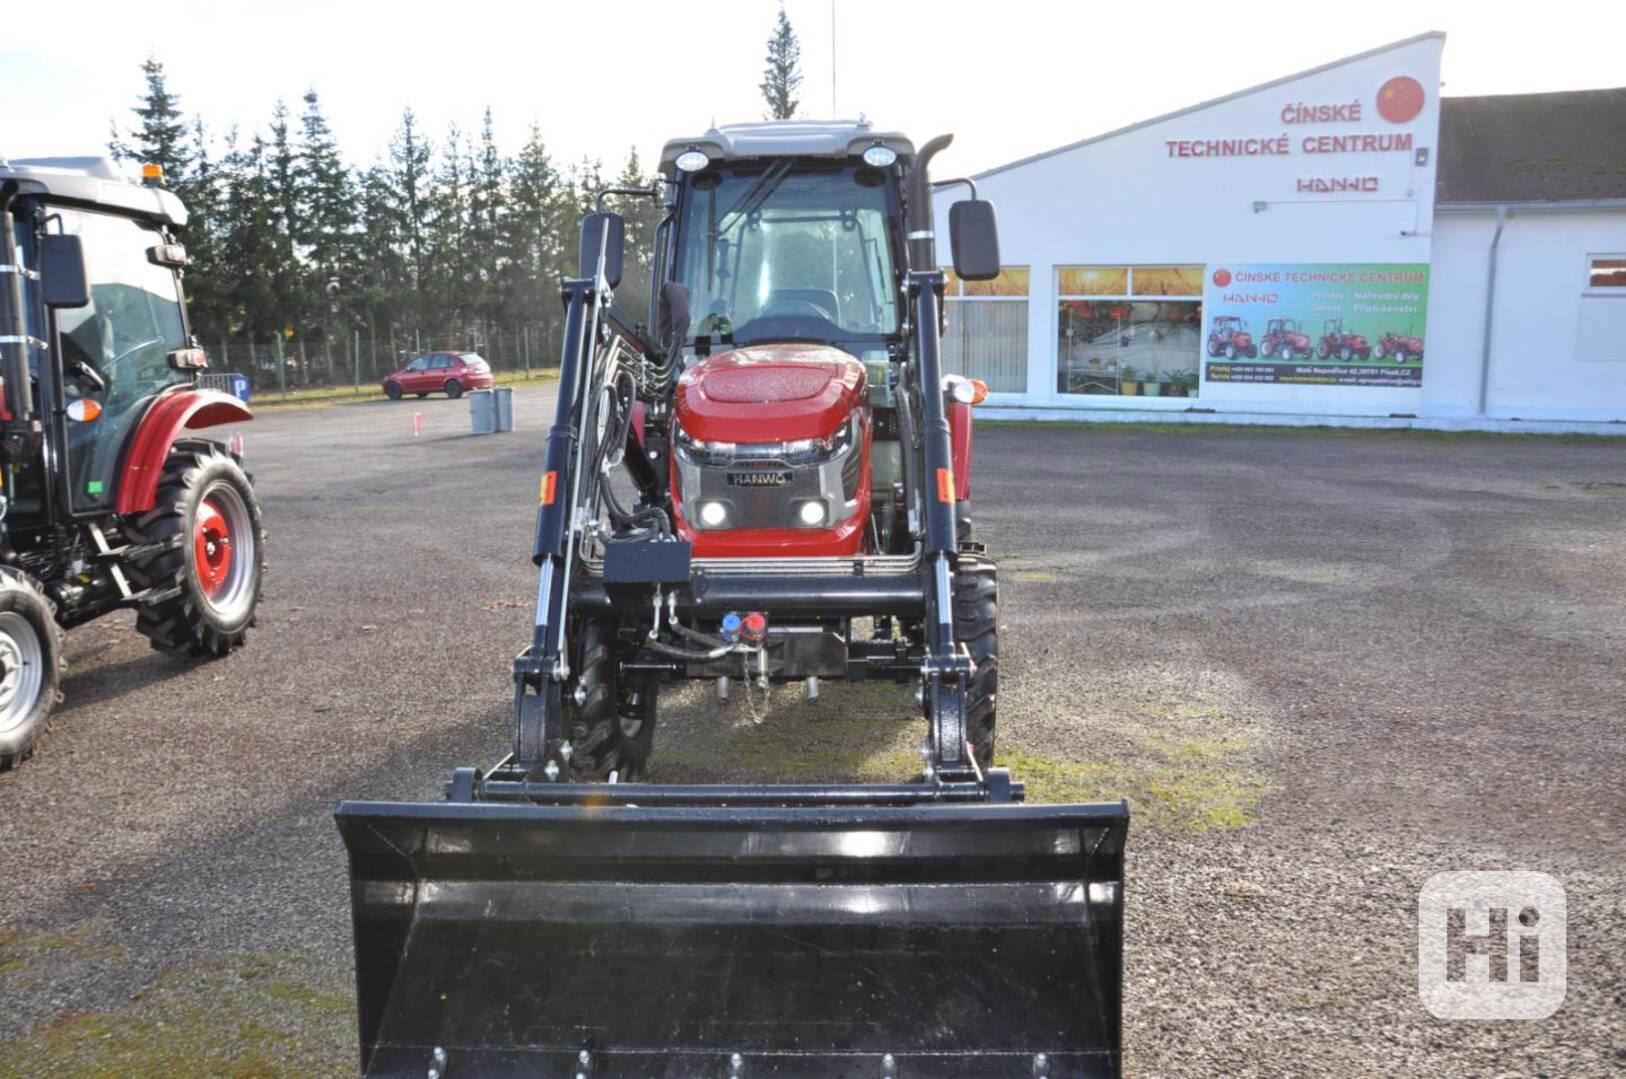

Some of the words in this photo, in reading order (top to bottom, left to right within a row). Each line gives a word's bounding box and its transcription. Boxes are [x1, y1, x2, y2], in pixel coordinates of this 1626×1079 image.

[1281, 99, 1361, 124] ČÍNSKÉ
[1166, 132, 1289, 157] TECHNICKÉ
[1302, 133, 1412, 154] CENTRUM
[1360, 271, 1424, 283] CENTRUM
[734, 473, 785, 484] HANWO
